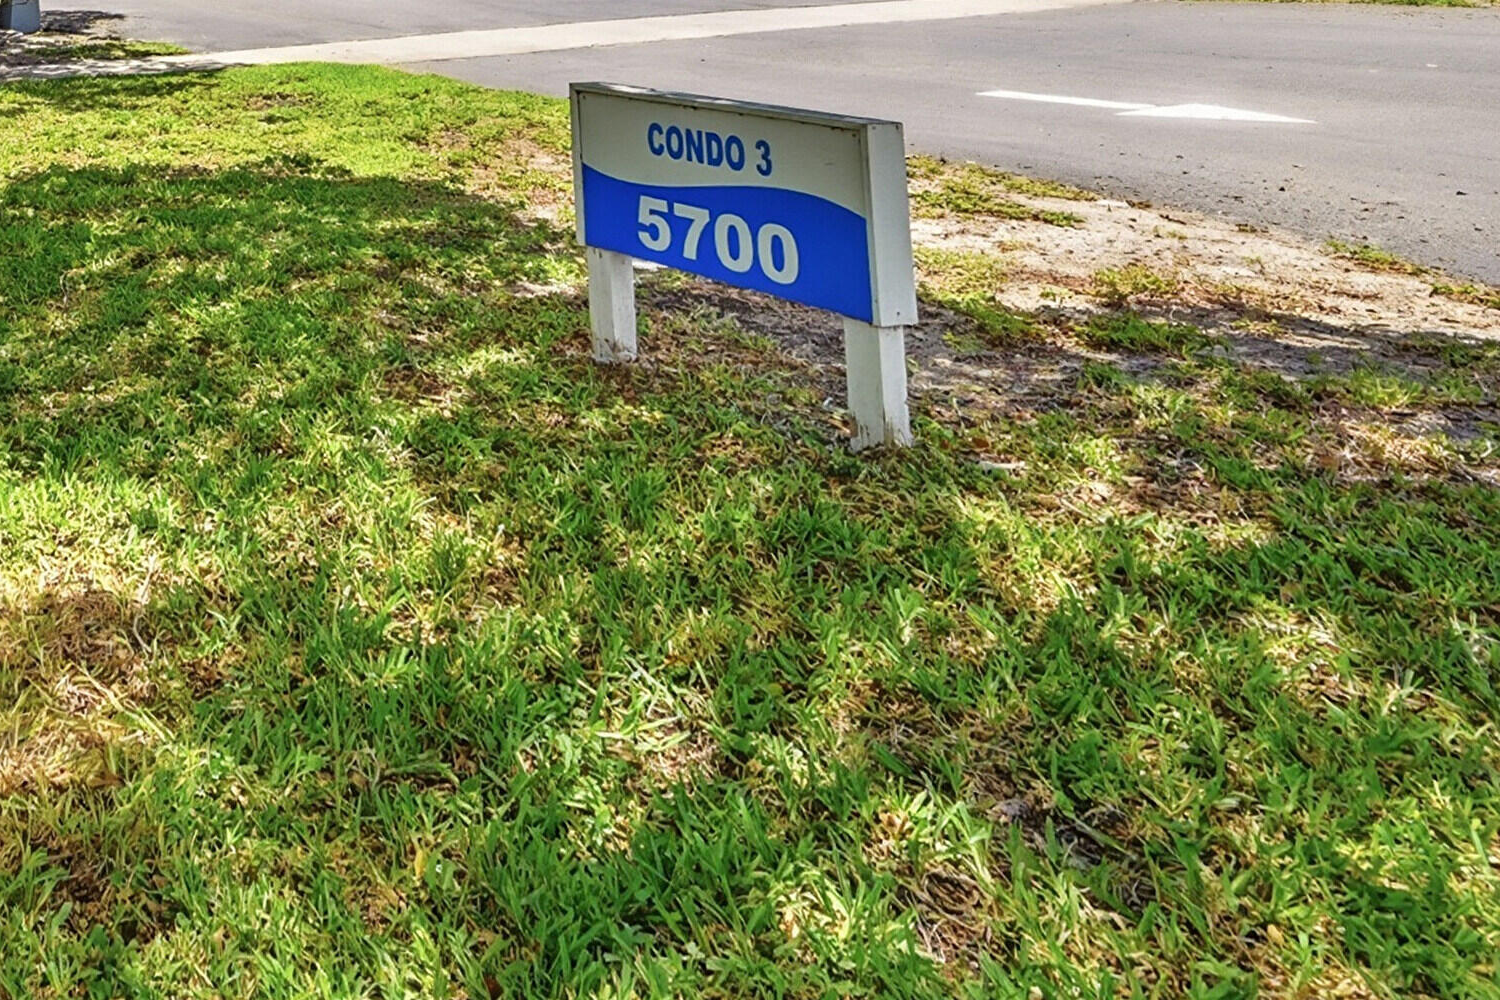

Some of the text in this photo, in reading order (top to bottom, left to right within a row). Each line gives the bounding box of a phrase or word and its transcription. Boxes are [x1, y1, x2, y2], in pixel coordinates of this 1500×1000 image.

[648, 122, 773, 176] CONDO 3
[638, 195, 799, 285] 5700
